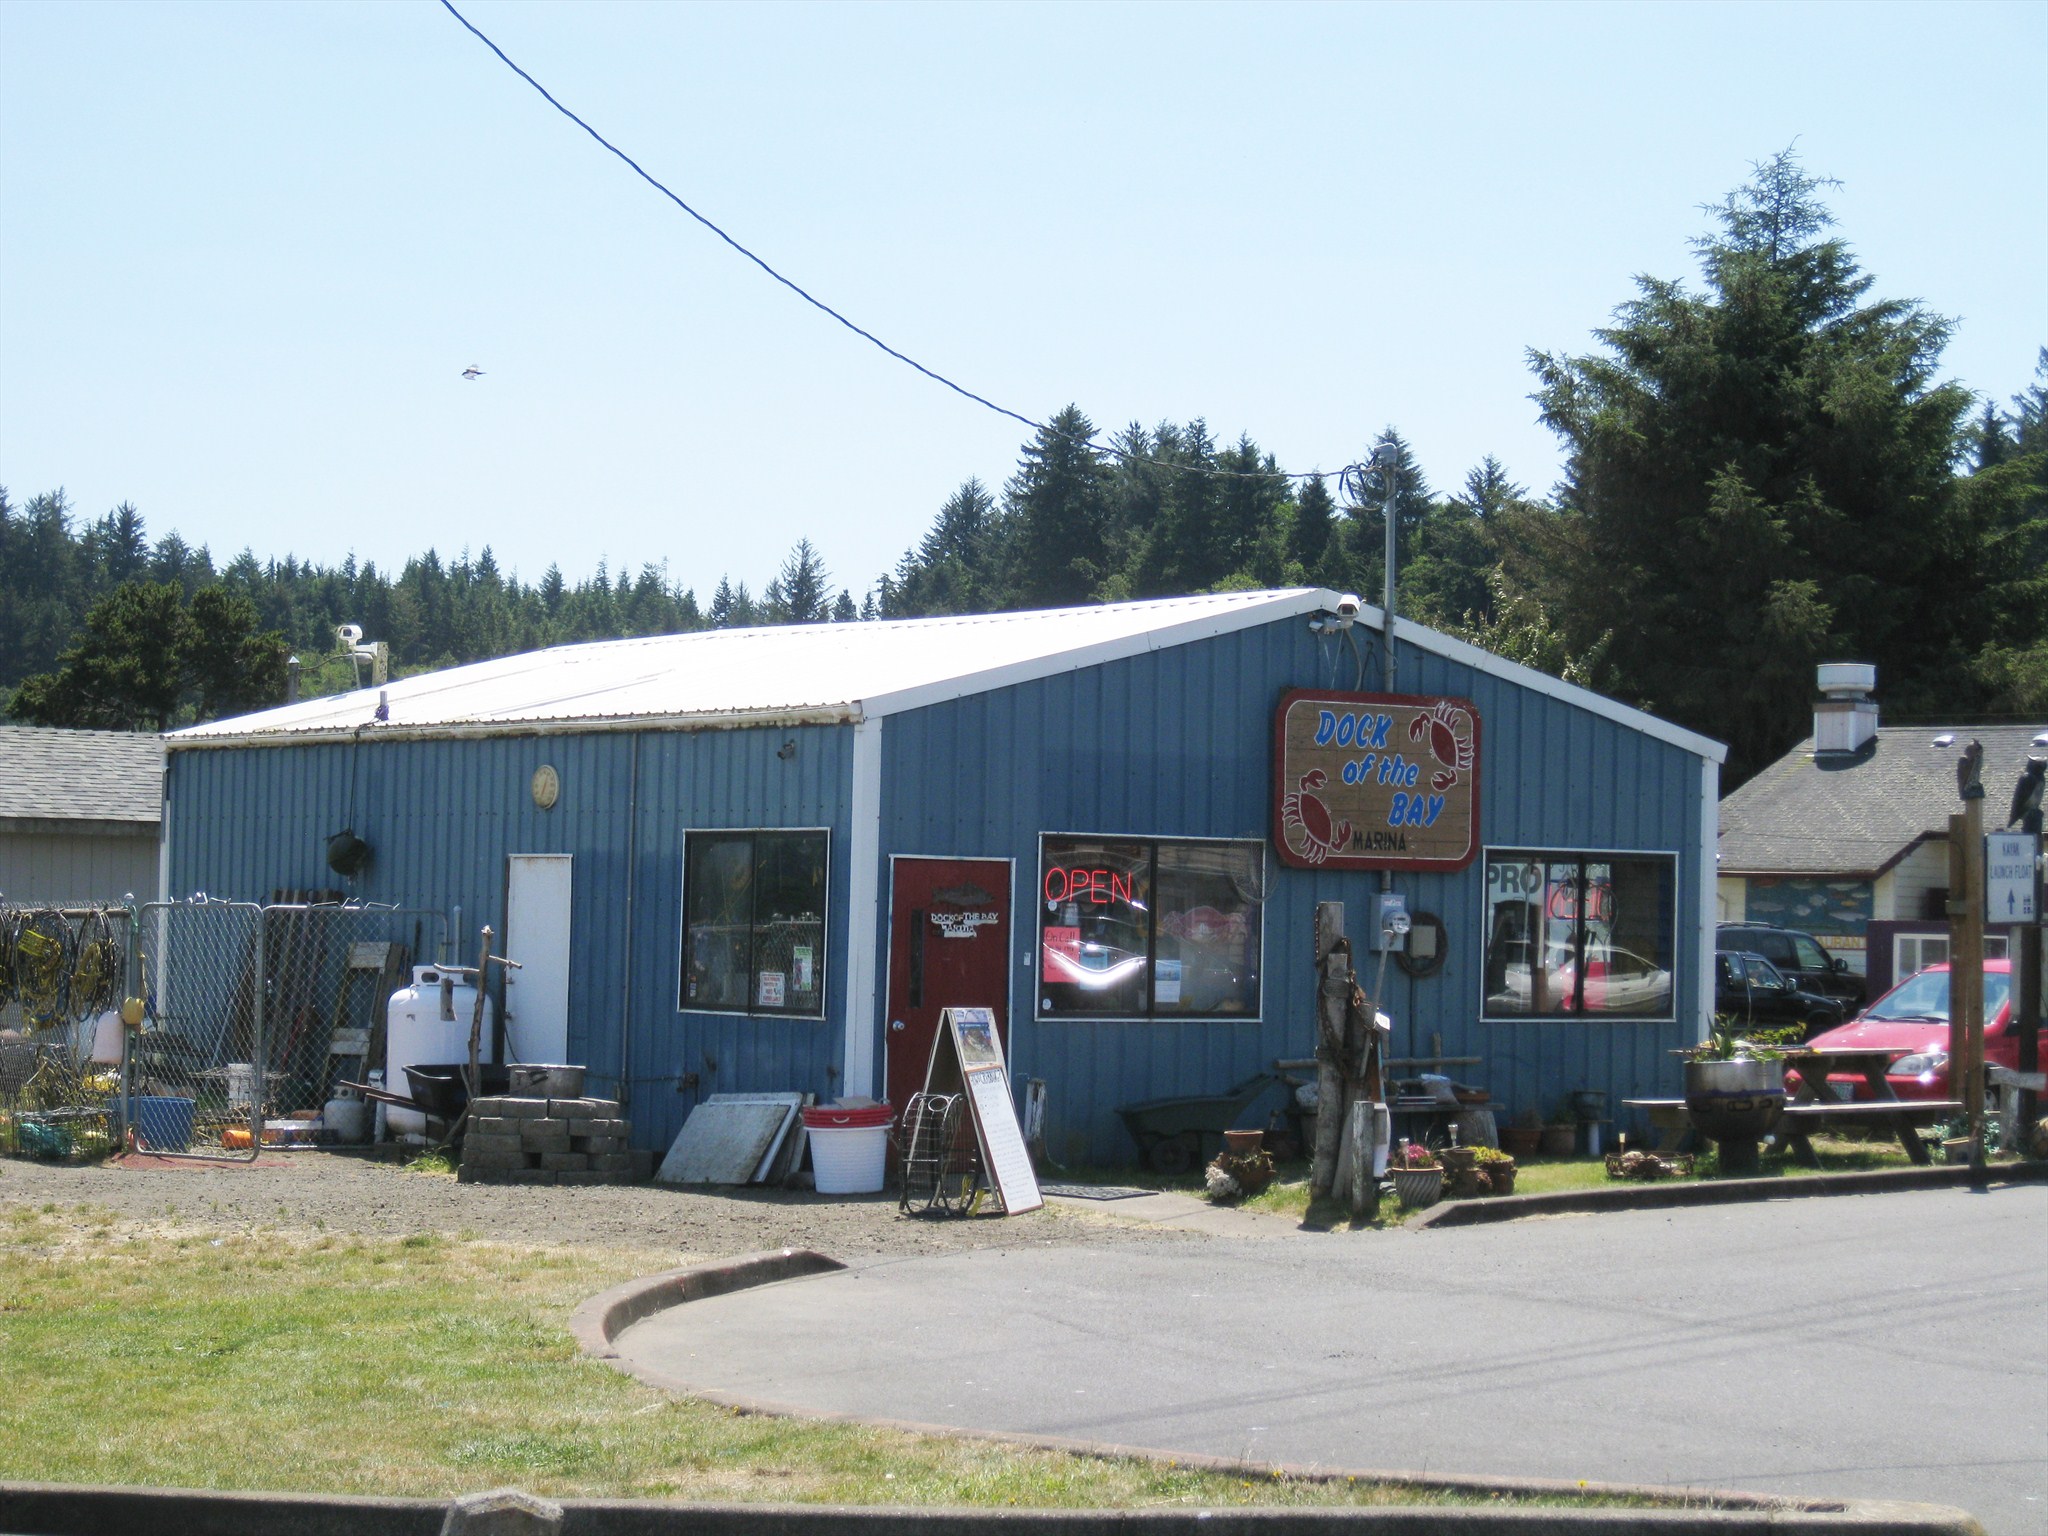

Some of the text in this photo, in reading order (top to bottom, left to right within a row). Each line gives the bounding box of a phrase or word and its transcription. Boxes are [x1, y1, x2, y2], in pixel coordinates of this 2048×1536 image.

[1314, 710, 1393, 749] DOCK
[1342, 753, 1419, 787] of the
[1387, 792, 1445, 828] BAY
[1353, 831, 1406, 851] MARINA
[1045, 867, 1133, 904] OPEN
[1488, 864, 1542, 894] PRO
[1990, 865, 2032, 879] LAUNCH FLOAT
[931, 913, 954, 922] DOCK
[963, 912, 980, 920] THE
[981, 912, 999, 920] BAY
